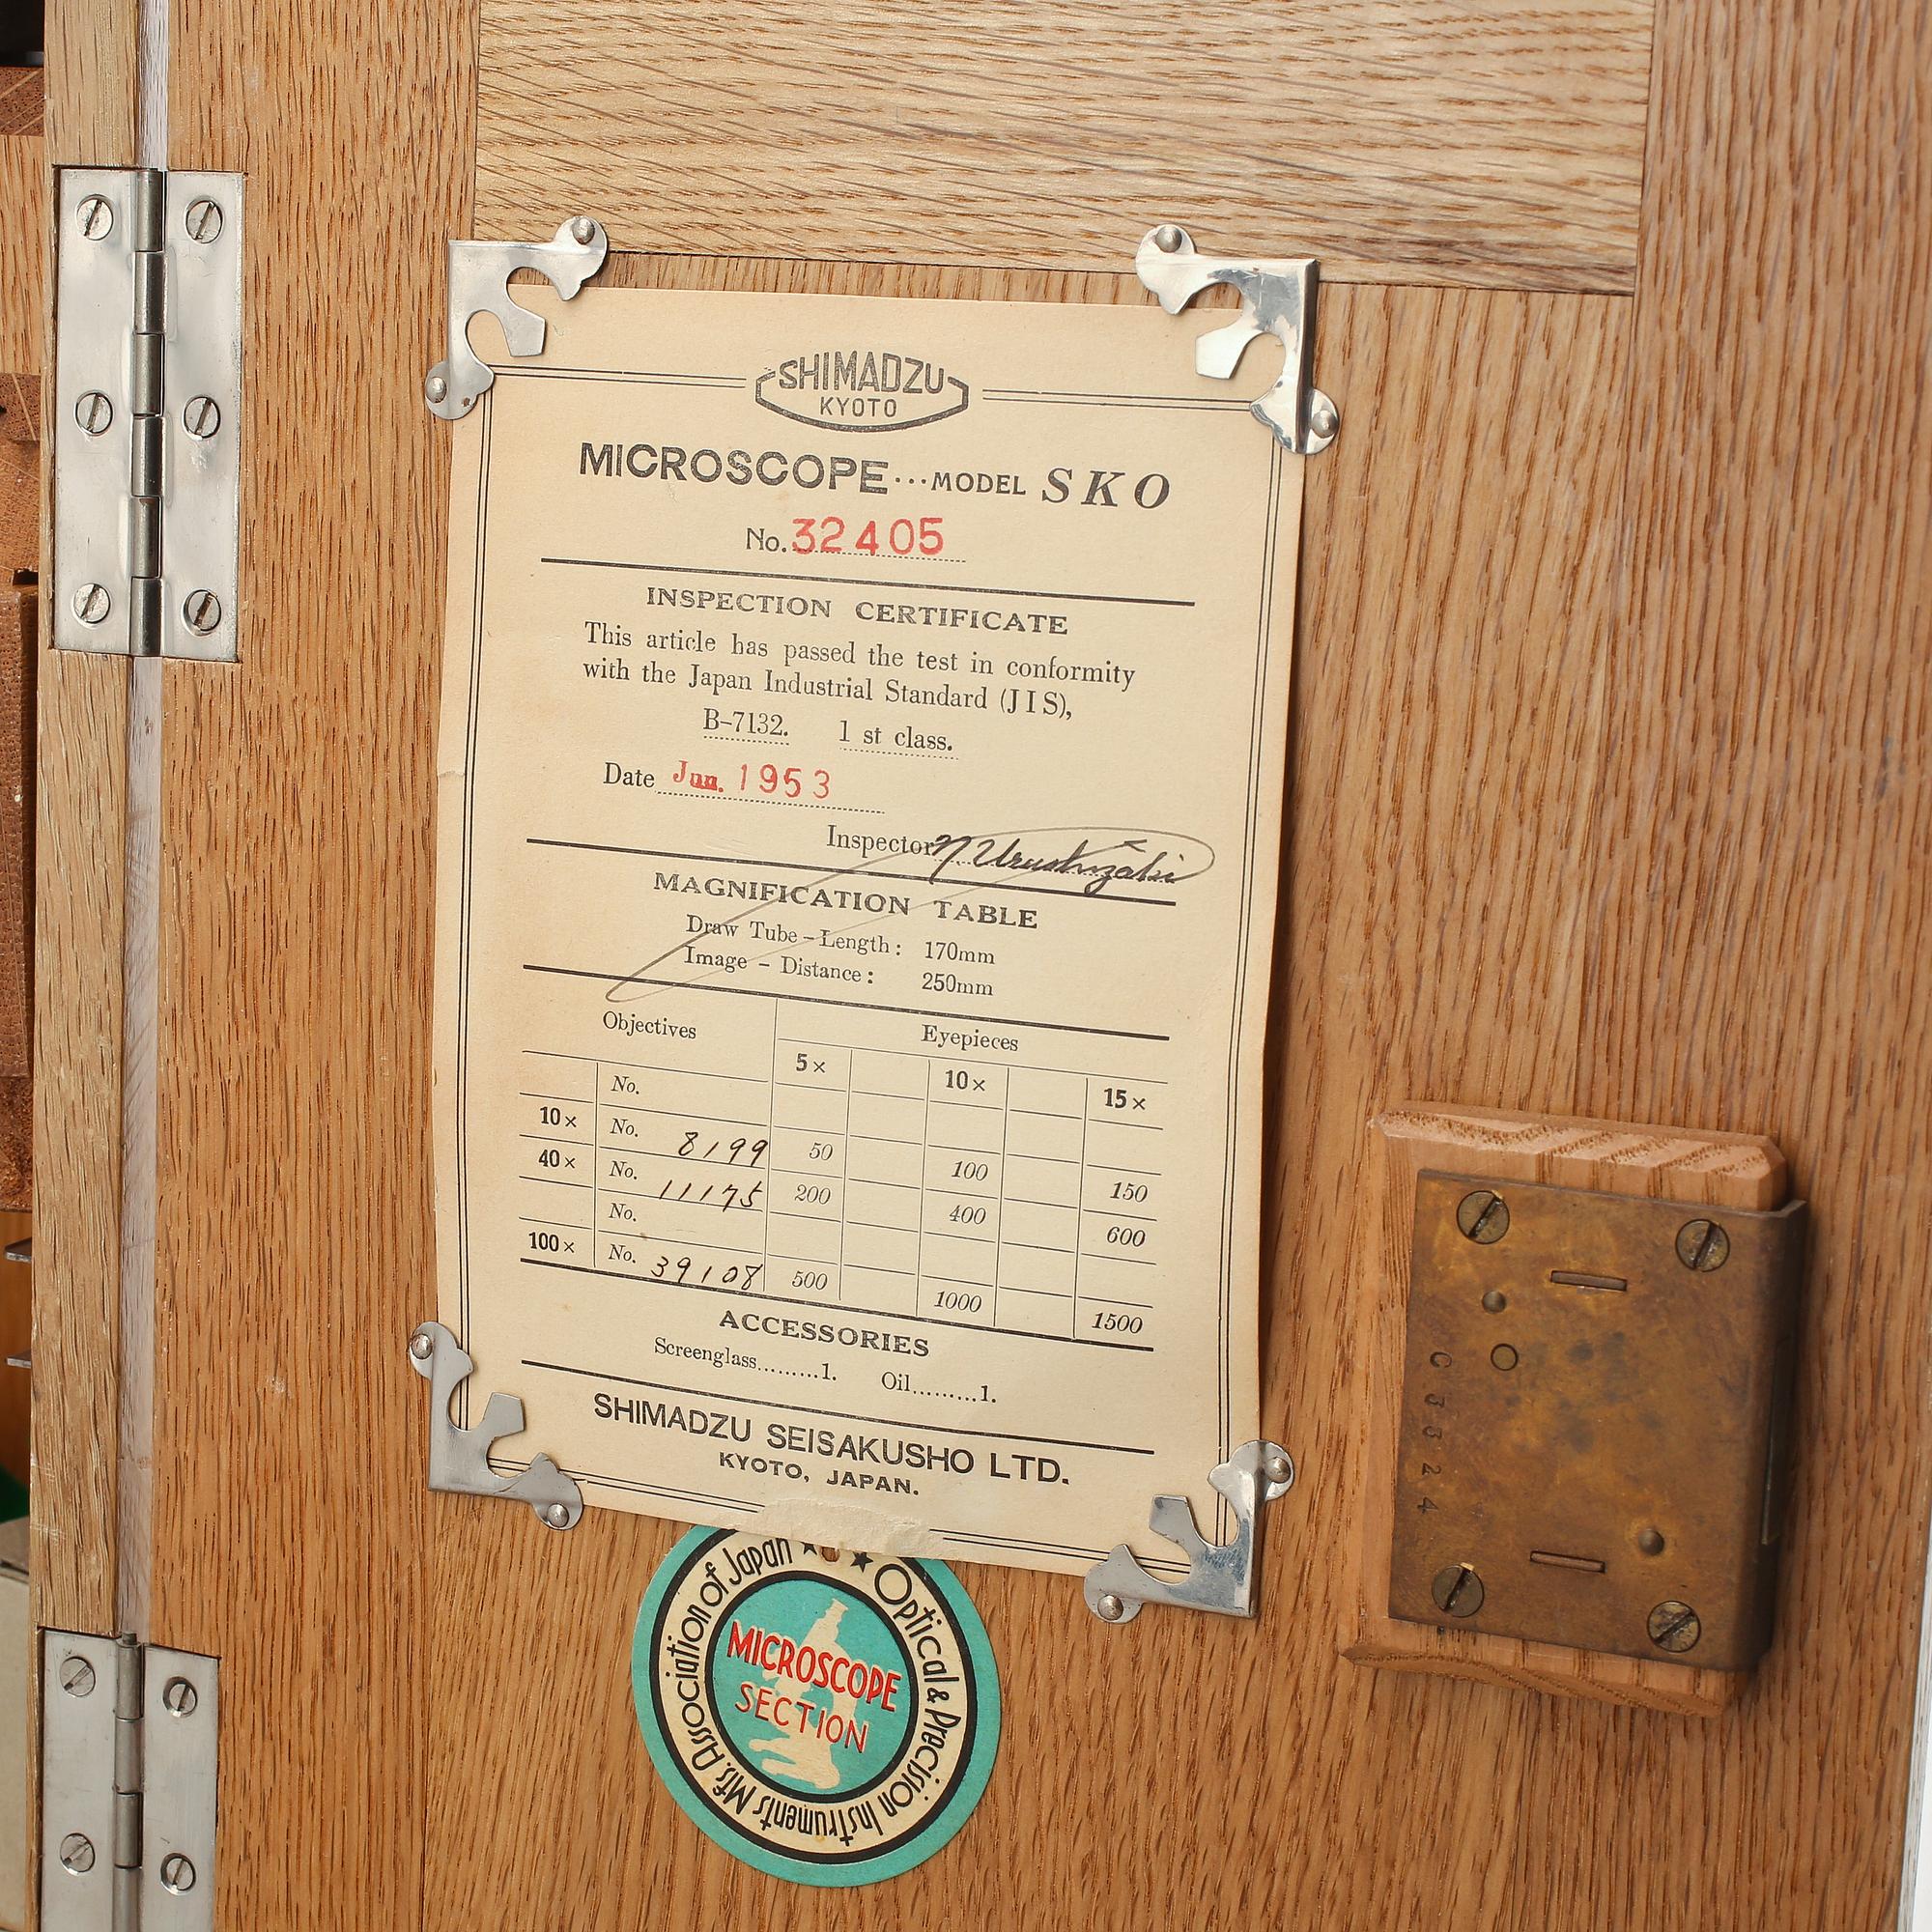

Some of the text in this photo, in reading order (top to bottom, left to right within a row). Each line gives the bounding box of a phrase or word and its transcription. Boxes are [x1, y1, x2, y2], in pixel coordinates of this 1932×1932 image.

[779, 350, 945, 395] SHIMADZU
[820, 396, 897, 418] KYOTO
[580, 441, 889, 496] MICROSCOPE
[930, 471, 1027, 496] MODEL
[745, 515, 945, 556] No. 32405
[646, 586, 1068, 636] INSPECTION CERTIFICATE
[584, 620, 1136, 693] This article has passed the test in conformity
[582, 657, 630, 681] with
[641, 660, 676, 684] the
[688, 663, 753, 696] Japan
[763, 668, 873, 701] Industrial
[885, 678, 987, 710] Standard
[895, 725, 953, 752] class.
[602, 761, 655, 788] Date
[740, 763, 832, 799] 1953
[826, 823, 935, 861] Inspector
[653, 871, 1038, 929] MAGNIFICATION TABLE
[685, 914, 740, 938] Draw
[924, 941, 996, 965] 170mm
[684, 946, 748, 973] Image
[921, 972, 993, 997] 250mm
[602, 1010, 696, 1039] Objectives
[920, 1023, 1019, 1052] Eyepieces
[610, 1074, 639, 1095] No.
[609, 1117, 639, 1138] No.
[676, 1131, 769, 1166] 8199
[809, 1142, 834, 1161] 50
[608, 1160, 638, 1180] No.
[951, 1160, 989, 1181] 100
[794, 1183, 832, 1206] 200
[1109, 1181, 1149, 1204] 150
[608, 1202, 637, 1223] No.
[949, 1205, 987, 1225] 400
[608, 1243, 637, 1264] No.
[1106, 1226, 1147, 1248] 600
[650, 1257, 764, 1292] 39108
[791, 1269, 828, 1291] 500
[933, 1291, 982, 1313] 1000
[719, 1309, 930, 1357] ACCESSORIES
[1091, 1312, 1144, 1334] 1500
[593, 1392, 1070, 1486] SHIMADZU SEISAKUSHO LTD.
[719, 1451, 920, 1496] KYOTO, JAPAN.
[722, 1539, 793, 1585] Japan
[700, 1562, 728, 1606] of
[874, 1564, 960, 1684] Optical
[726, 1621, 902, 1713] MICROSCOPE
[666, 1605, 725, 1770] Association
[927, 1689, 950, 1702] &
[734, 1683, 868, 1754] SECTION
[880, 1709, 961, 1817] Precision
[753, 1795, 884, 1846] Instruments
